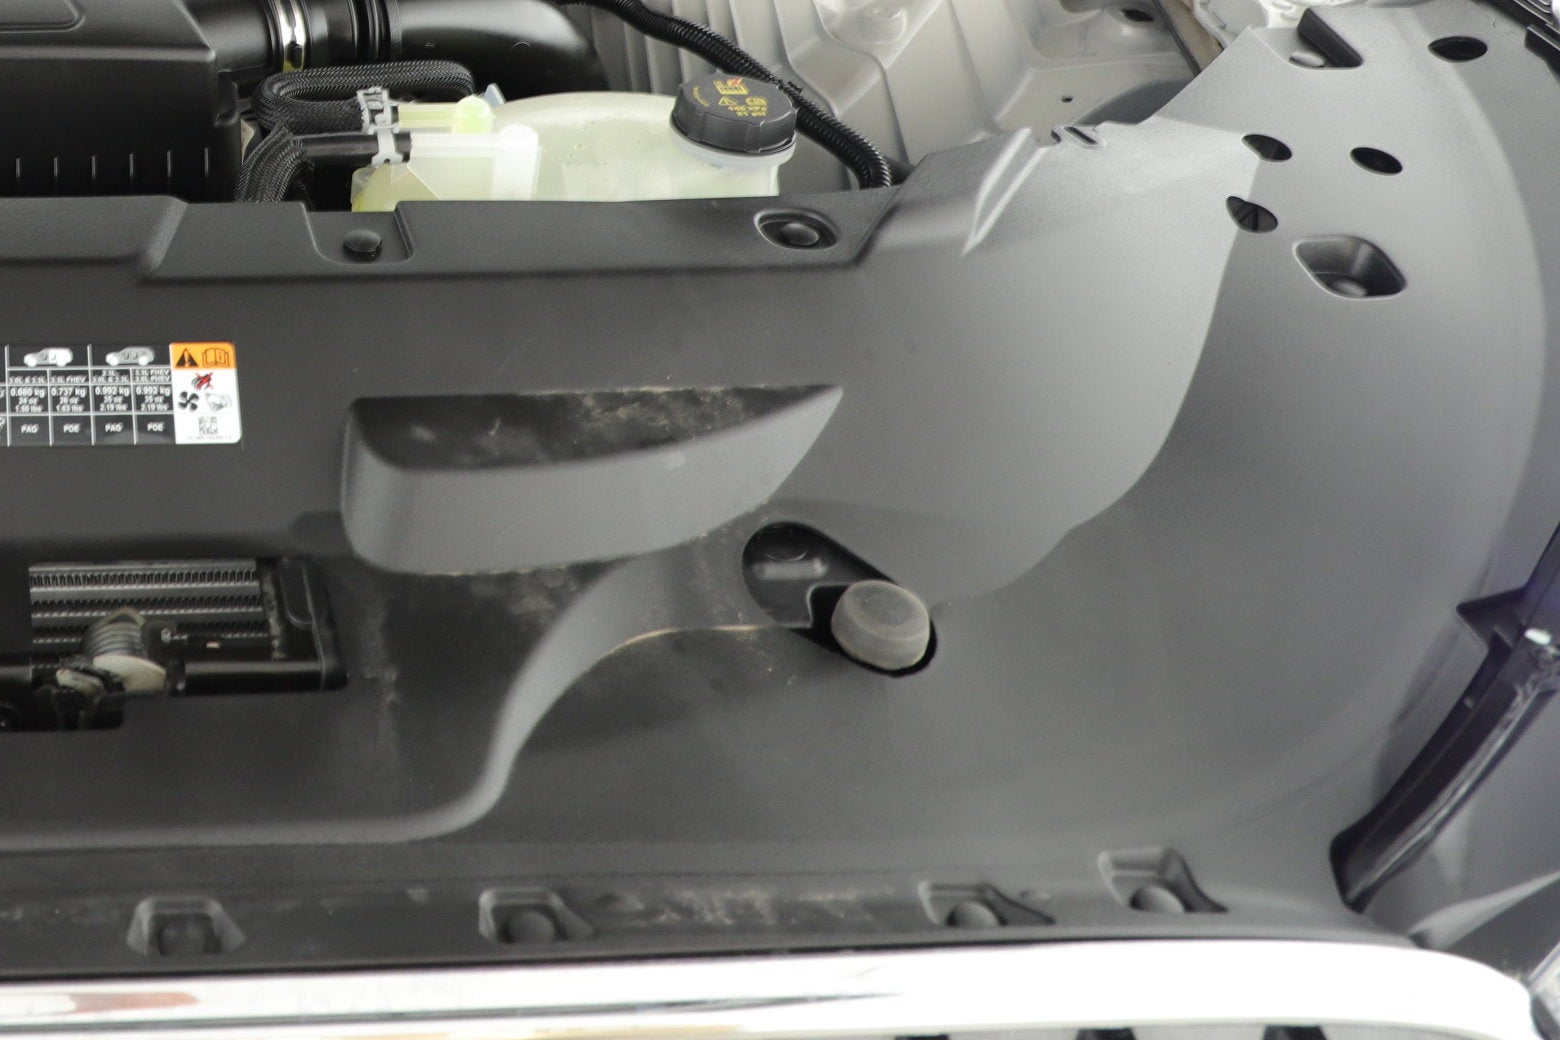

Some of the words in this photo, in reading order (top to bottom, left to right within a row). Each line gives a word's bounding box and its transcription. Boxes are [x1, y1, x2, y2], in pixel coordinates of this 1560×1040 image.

[10, 387, 34, 397] 0.680
[35, 387, 46, 398] kg
[51, 387, 74, 396] 0.737
[75, 387, 87, 398] kg
[95, 386, 118, 396] 0.992
[119, 386, 131, 397] kg
[136, 386, 158, 395] 0.992
[160, 386, 172, 397] kg
[104, 395, 113, 403] 35
[144, 395, 154, 403] 35
[31, 405, 43, 413] lbs
[71, 405, 84, 413] lbs
[100, 403, 115, 411] 2.19
[116, 403, 128, 411] lbs
[140, 403, 155, 411] 2.19
[156, 403, 169, 411] lbs
[21, 424, 39, 434] PAG
[63, 423, 81, 433] POE
[105, 423, 123, 433] PAG
[147, 422, 165, 432] POE
